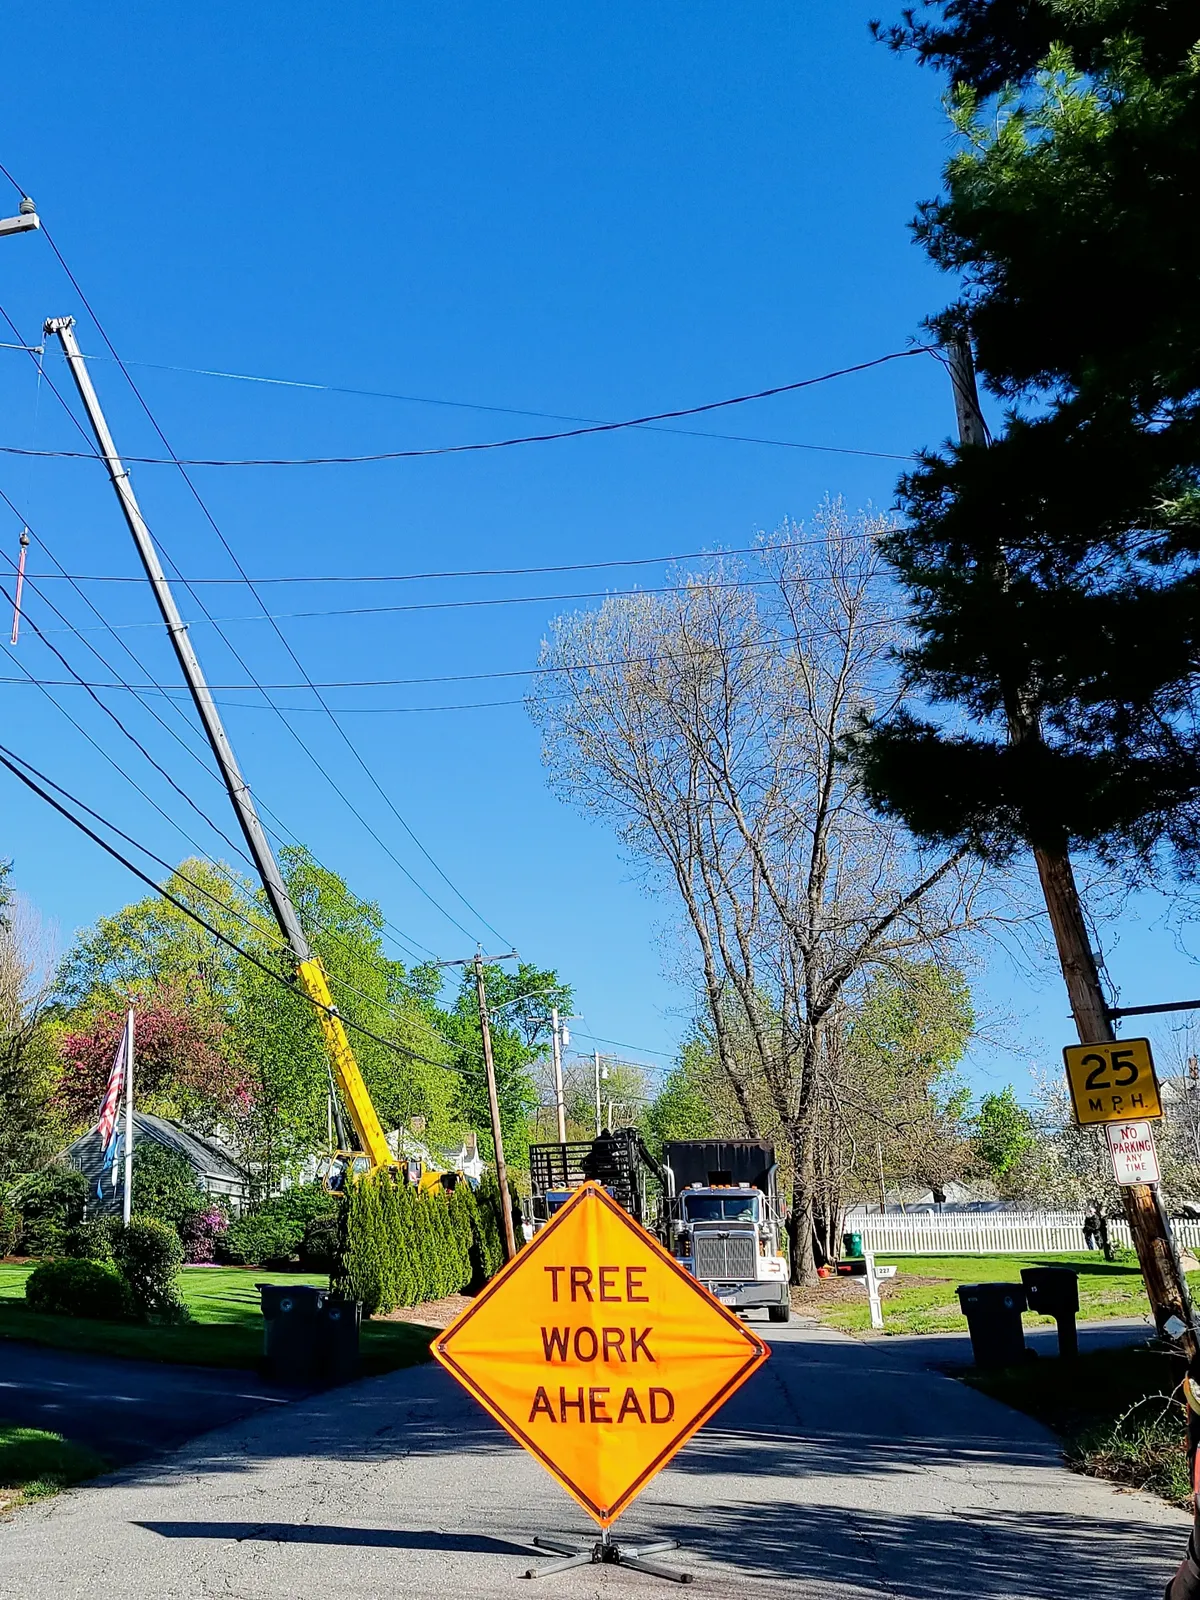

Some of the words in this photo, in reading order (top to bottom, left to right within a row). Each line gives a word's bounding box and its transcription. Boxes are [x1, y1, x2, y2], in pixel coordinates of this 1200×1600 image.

[1081, 1050, 1139, 1090] 25
[1120, 1127, 1138, 1140] NO
[1112, 1140, 1152, 1154] PARKING
[1125, 1153, 1143, 1162] ANY
[1125, 1163, 1147, 1172] TIME
[544, 1266, 650, 1303] TREE
[540, 1326, 656, 1363] WORK
[528, 1386, 675, 1424] AHEAD
